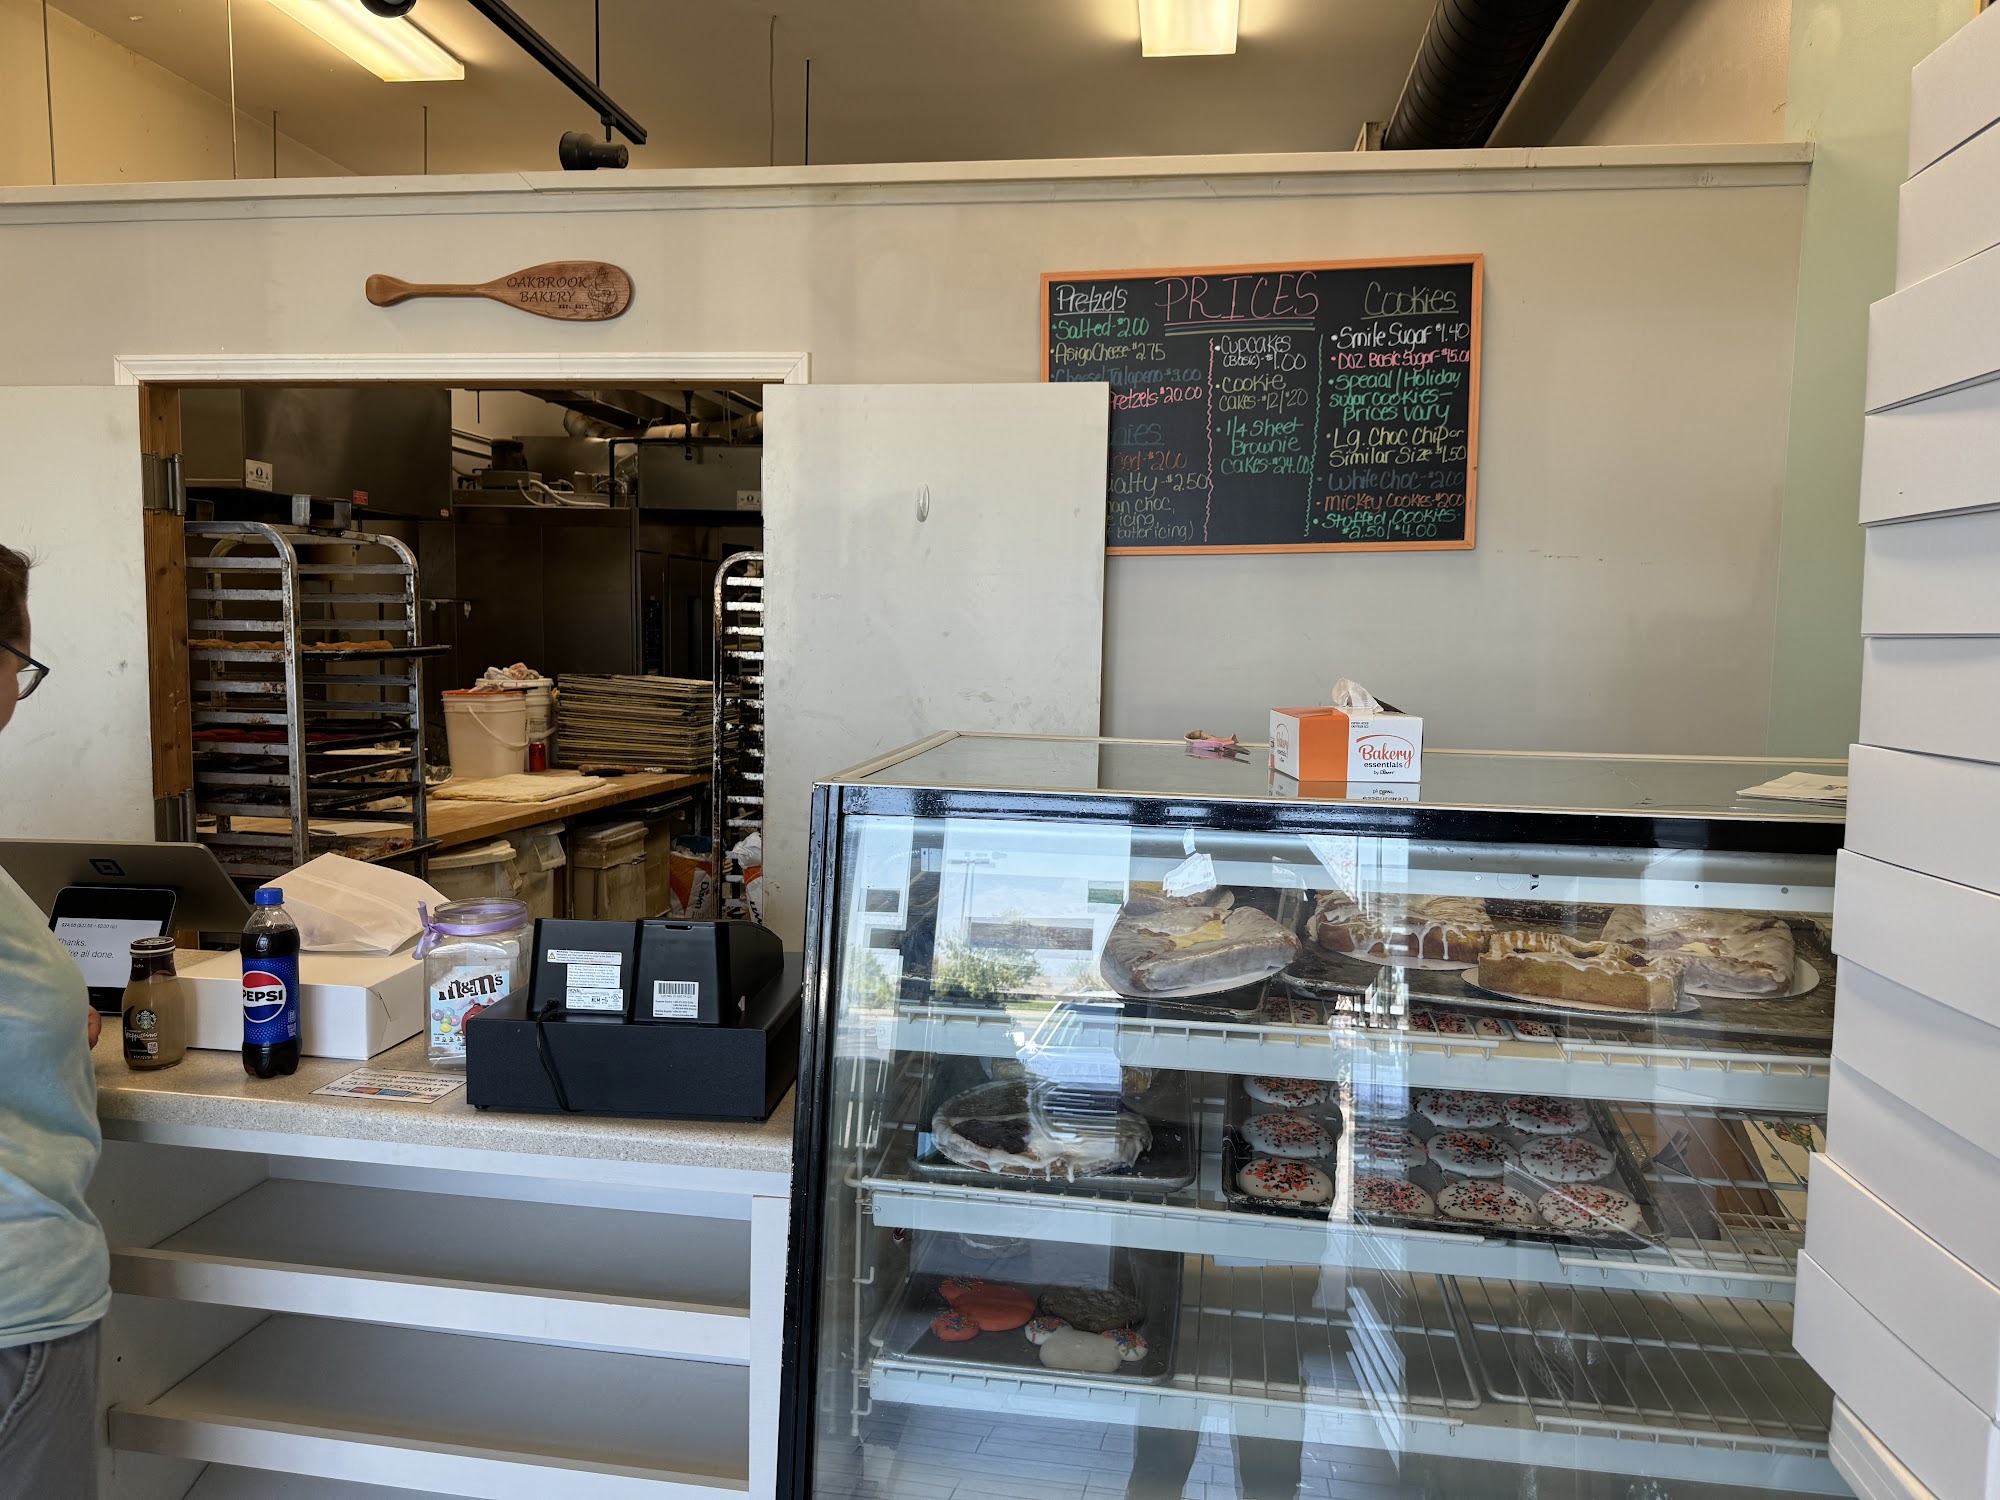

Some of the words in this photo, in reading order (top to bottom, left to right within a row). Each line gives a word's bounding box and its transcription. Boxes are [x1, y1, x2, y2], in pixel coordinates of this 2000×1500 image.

[506, 276, 588, 289] OAKBROOK
[519, 290, 576, 303] BAKERY
[1055, 284, 1128, 313] Pretzels
[1154, 271, 1319, 321] PRICES
[1364, 281, 1457, 316] Cookies
[1337, 321, 1386, 349] Smile
[1369, 350, 1401, 367] Basic
[1226, 415, 1248, 438] 1/4
[1369, 426, 1408, 446] Choc
[1449, 429, 1464, 438] or
[1231, 435, 1301, 457] Brownie
[1329, 446, 1395, 467] Similar
[1322, 510, 1387, 529] Stuffed
[1358, 742, 1412, 769] Bakery
[92, 950, 114, 959] done.
